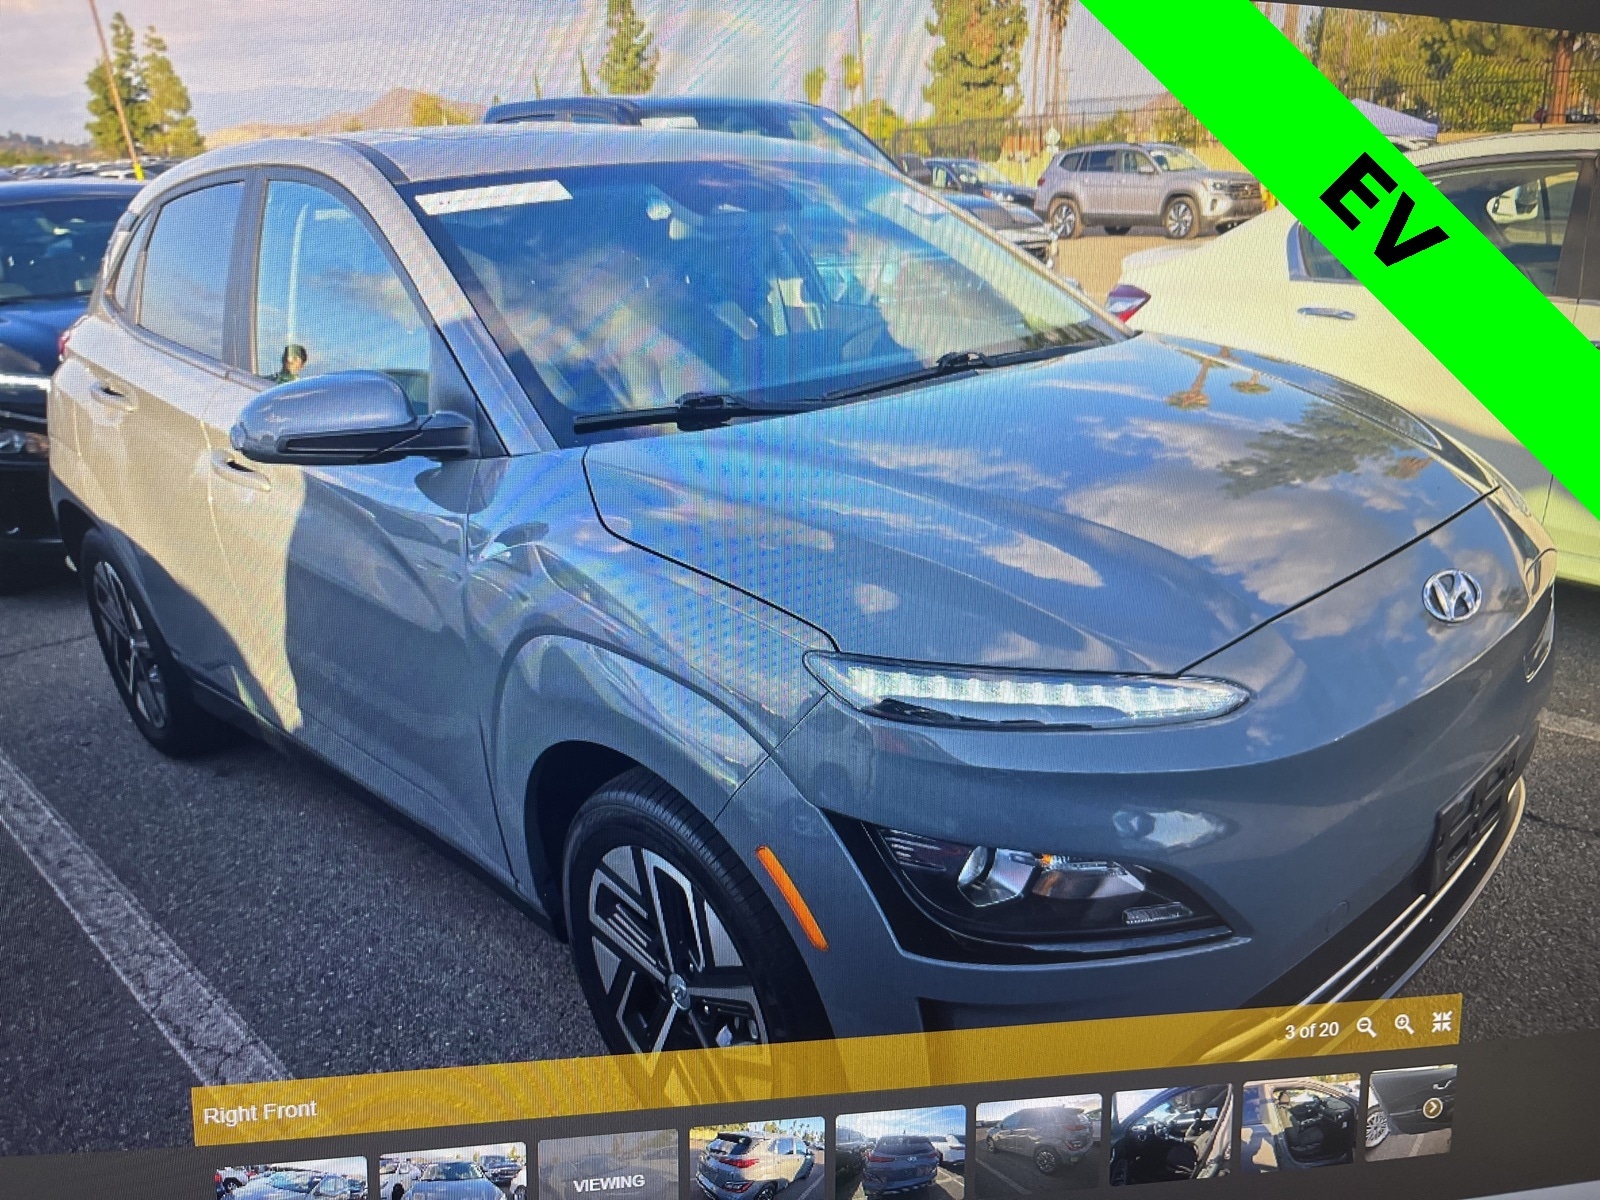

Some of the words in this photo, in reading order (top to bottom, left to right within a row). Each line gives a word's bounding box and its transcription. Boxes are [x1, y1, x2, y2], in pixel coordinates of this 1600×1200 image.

[1285, 1024, 1296, 1040] 3
[1299, 1023, 1317, 1039] of
[1319, 1021, 1340, 1037] 20
[203, 1105, 258, 1127] Right
[263, 1100, 317, 1120] Front
[573, 1174, 646, 1193] VIEWING
